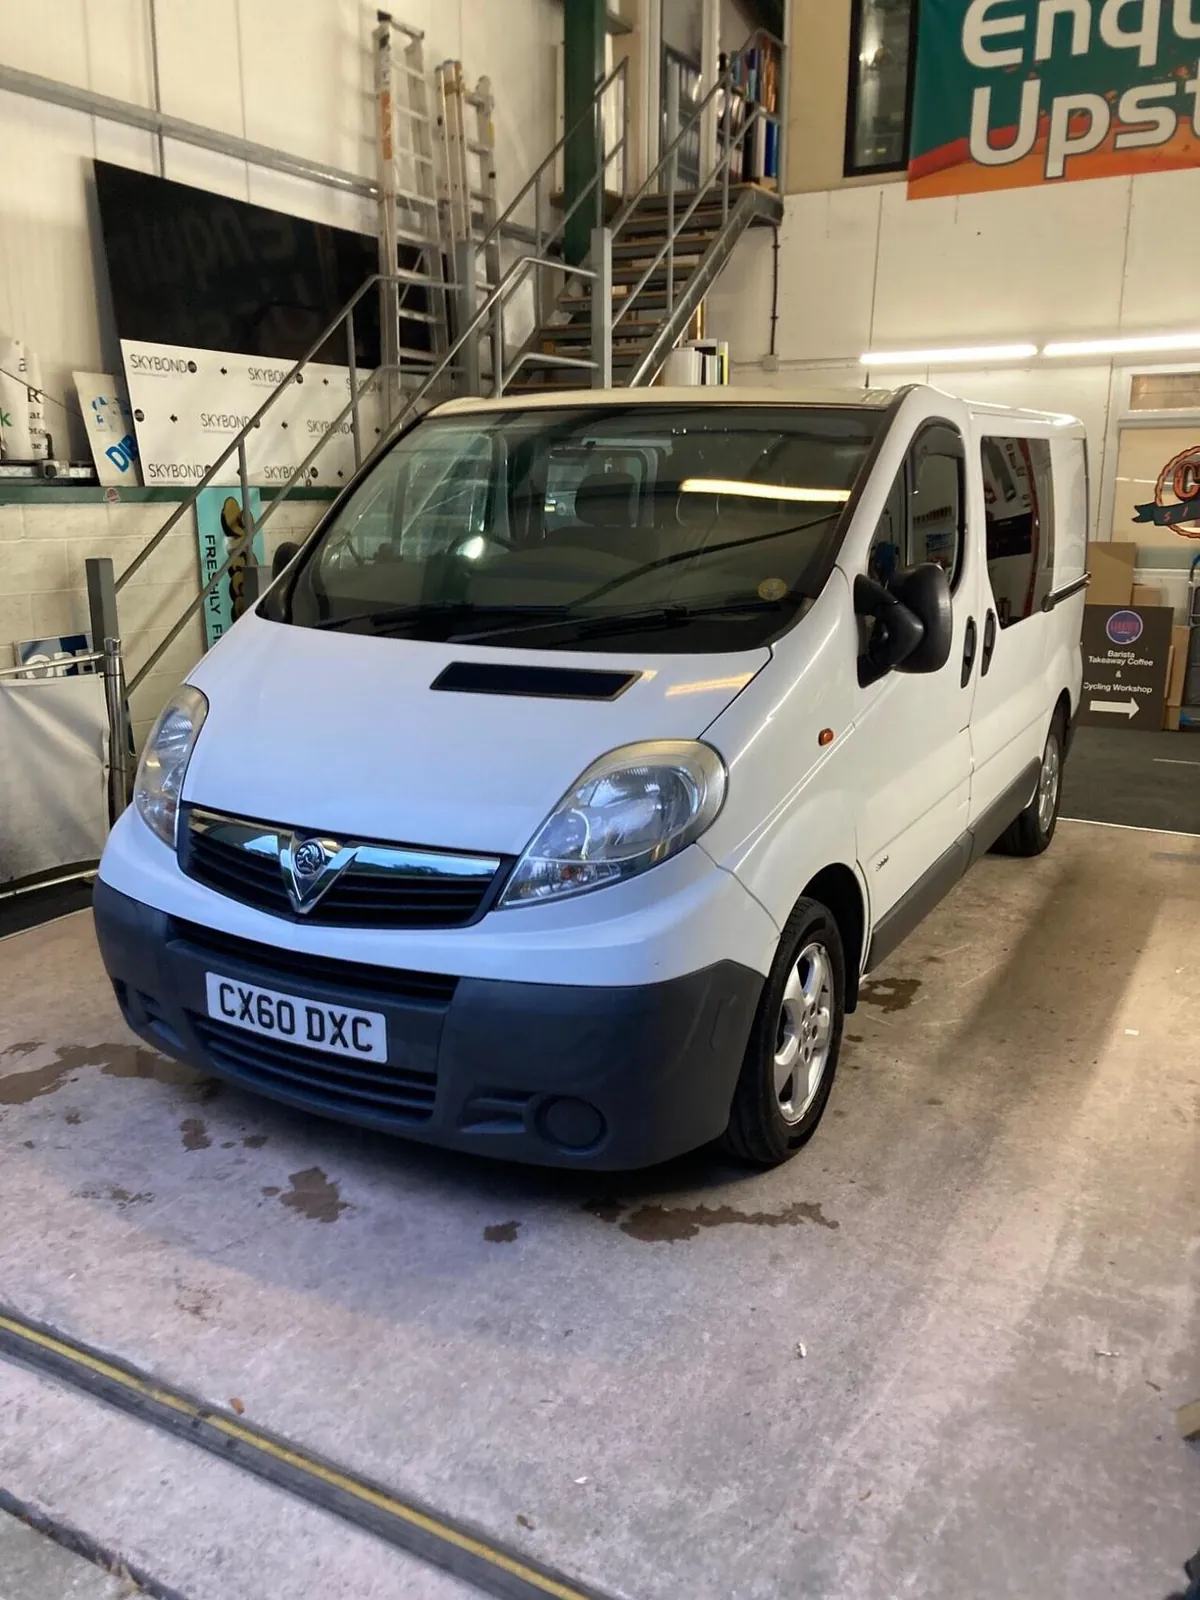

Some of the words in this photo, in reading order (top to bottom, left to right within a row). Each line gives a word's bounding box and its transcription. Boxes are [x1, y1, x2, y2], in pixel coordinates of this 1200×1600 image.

[129, 354, 188, 374] SKYBOND
[148, 463, 204, 478] SKYBOND
[1107, 650, 1135, 658] Barista
[1088, 656, 1126, 666] Takeaway
[1127, 658, 1154, 667] Coffee
[1115, 670, 1122, 678] &
[1112, 684, 1152, 694] Workshop
[219, 982, 295, 1035] CX60
[305, 1006, 373, 1053] DXC
